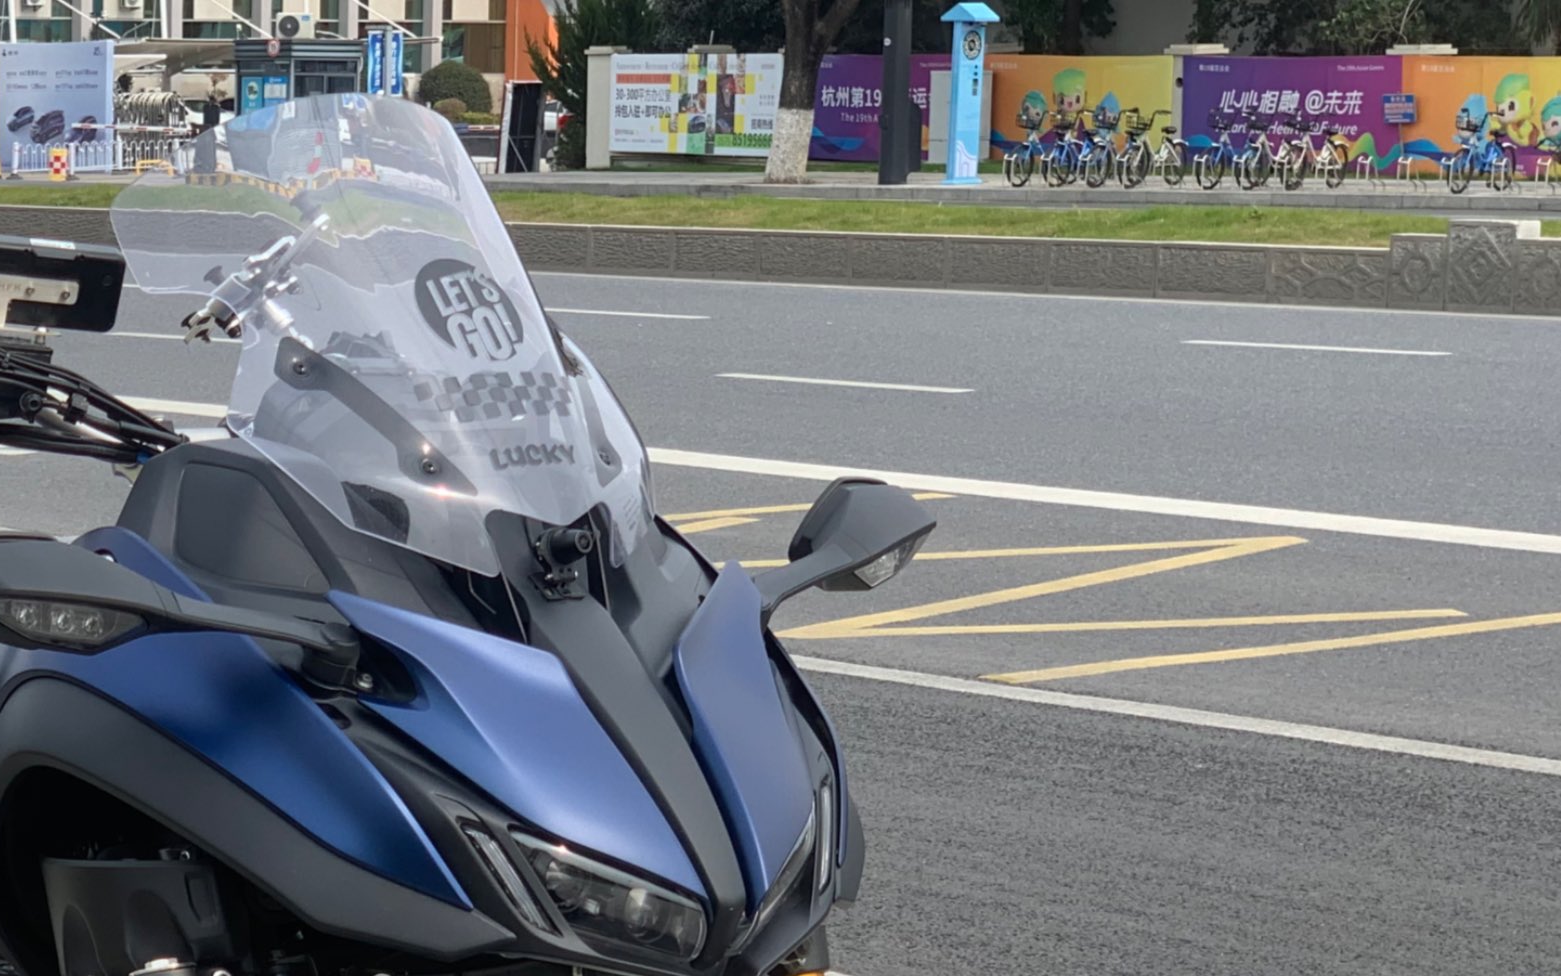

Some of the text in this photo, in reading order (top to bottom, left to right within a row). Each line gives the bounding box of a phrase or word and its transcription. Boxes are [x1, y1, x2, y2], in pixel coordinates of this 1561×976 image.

[841, 112, 854, 122] The
[855, 113, 872, 122] 19th
[426, 268, 502, 317] LET'S
[446, 303, 519, 361] GO!
[490, 443, 577, 472] LUCKY
